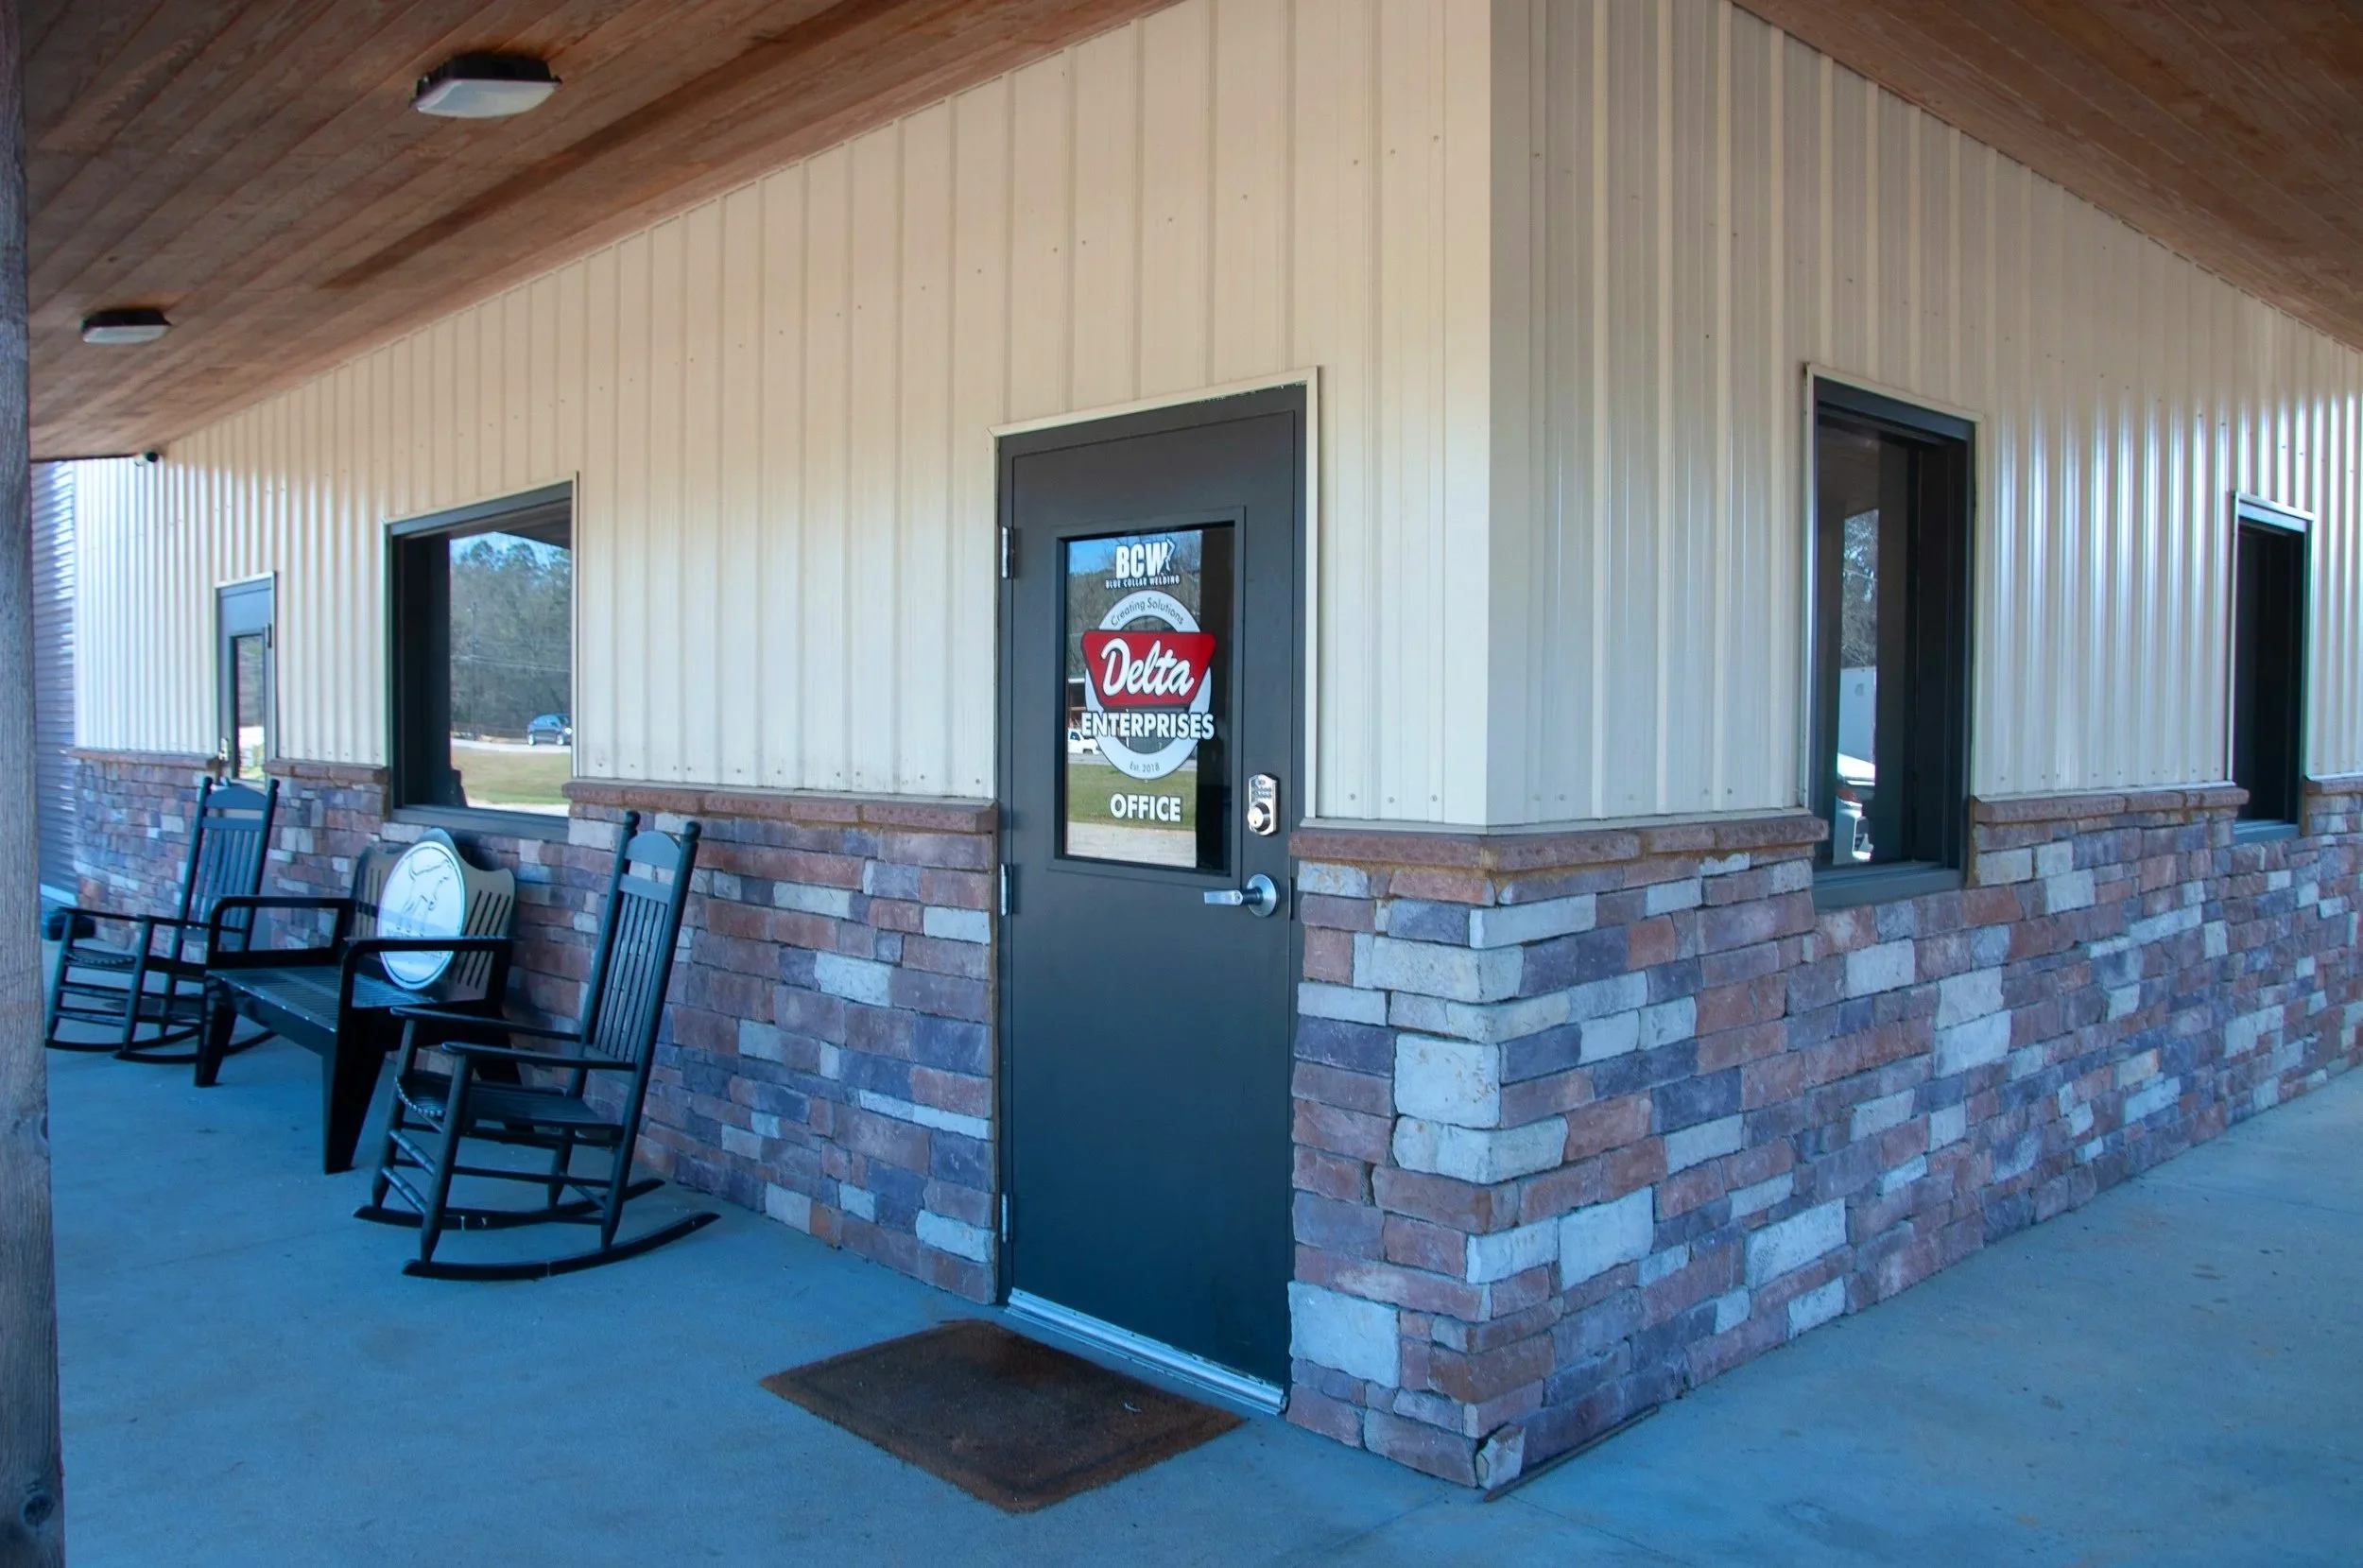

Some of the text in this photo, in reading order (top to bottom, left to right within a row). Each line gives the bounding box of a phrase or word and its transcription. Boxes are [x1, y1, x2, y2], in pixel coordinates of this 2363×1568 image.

[1115, 541, 1169, 579] BCW
[1105, 575, 1180, 589] BLUE COLLAR WELDING
[1111, 597, 1183, 626] Creating Solutions
[1101, 638, 1195, 697] Delta
[1081, 712, 1215, 740] ENTERPRISES
[1142, 762, 1161, 773] 2018
[1110, 793, 1182, 822] OFFICE
